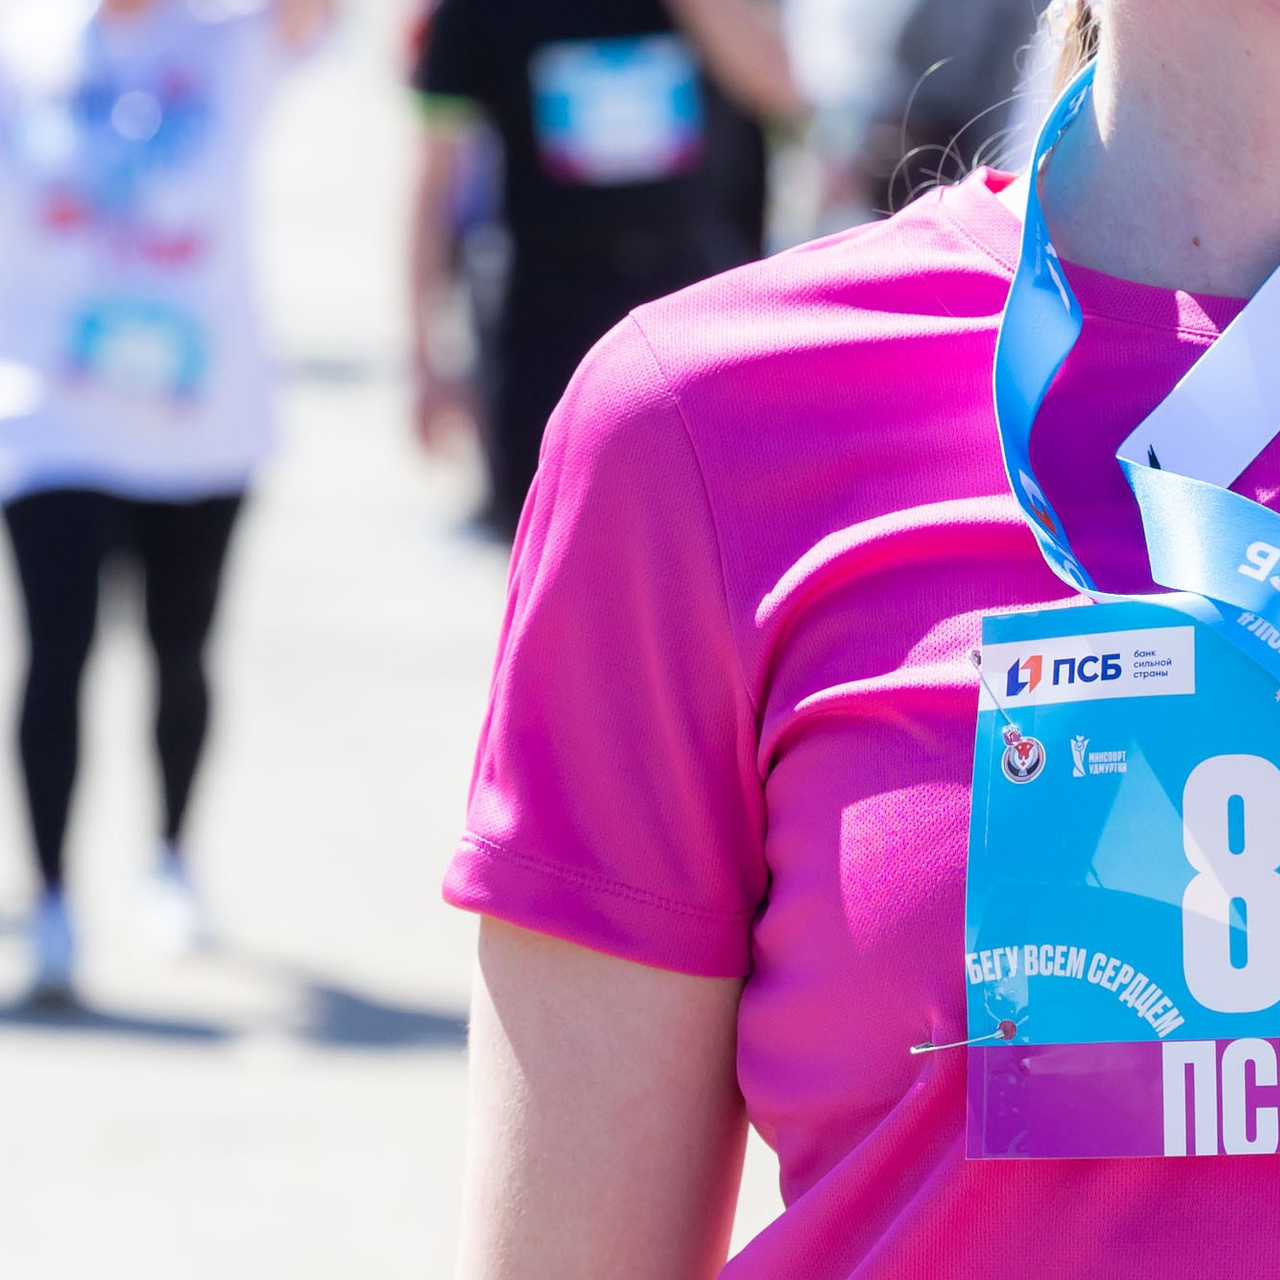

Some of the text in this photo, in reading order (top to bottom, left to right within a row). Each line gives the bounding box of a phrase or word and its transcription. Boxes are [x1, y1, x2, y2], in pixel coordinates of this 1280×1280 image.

[1133, 649, 1156, 658] банк
[1133, 657, 1172, 668] сильной
[1053, 653, 1122, 686] ПСБ
[1133, 669, 1169, 680] страны
[965, 945, 1185, 1038] БЕГУ ВСЕМ СЕРДЦЕМ
